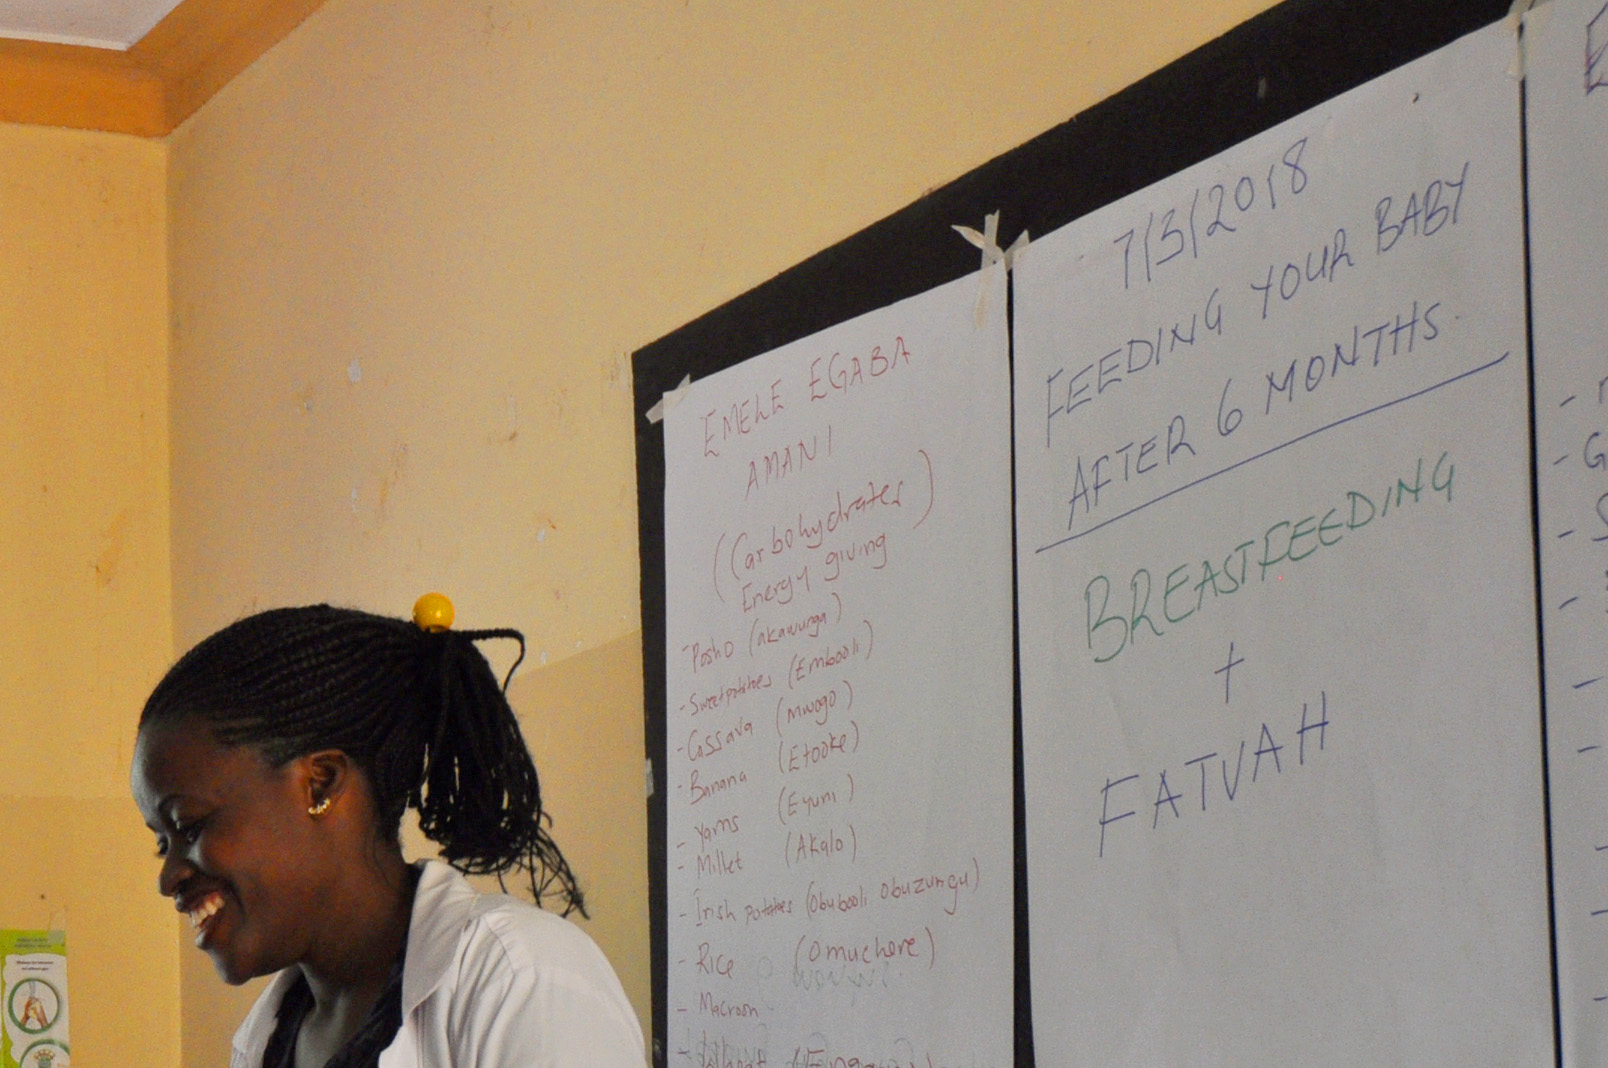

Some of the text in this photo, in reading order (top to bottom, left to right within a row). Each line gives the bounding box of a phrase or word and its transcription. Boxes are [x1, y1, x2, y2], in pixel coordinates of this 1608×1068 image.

[1044, 160, 1471, 448] FEEDING YOUR BABY
[809, 335, 912, 402] EGABA
[744, 424, 833, 502] AMANI
[1066, 413, 1197, 532] AFTER
[1216, 377, 1244, 438] 6
[742, 532, 887, 614] Energy giving
[1083, 450, 1457, 665] BREASTFEEDING
[687, 716, 754, 762] Cassava
[690, 768, 748, 806] Banana
[694, 814, 740, 853] Yams
[696, 848, 744, 880] Millet
[693, 887, 737, 928] Irish
